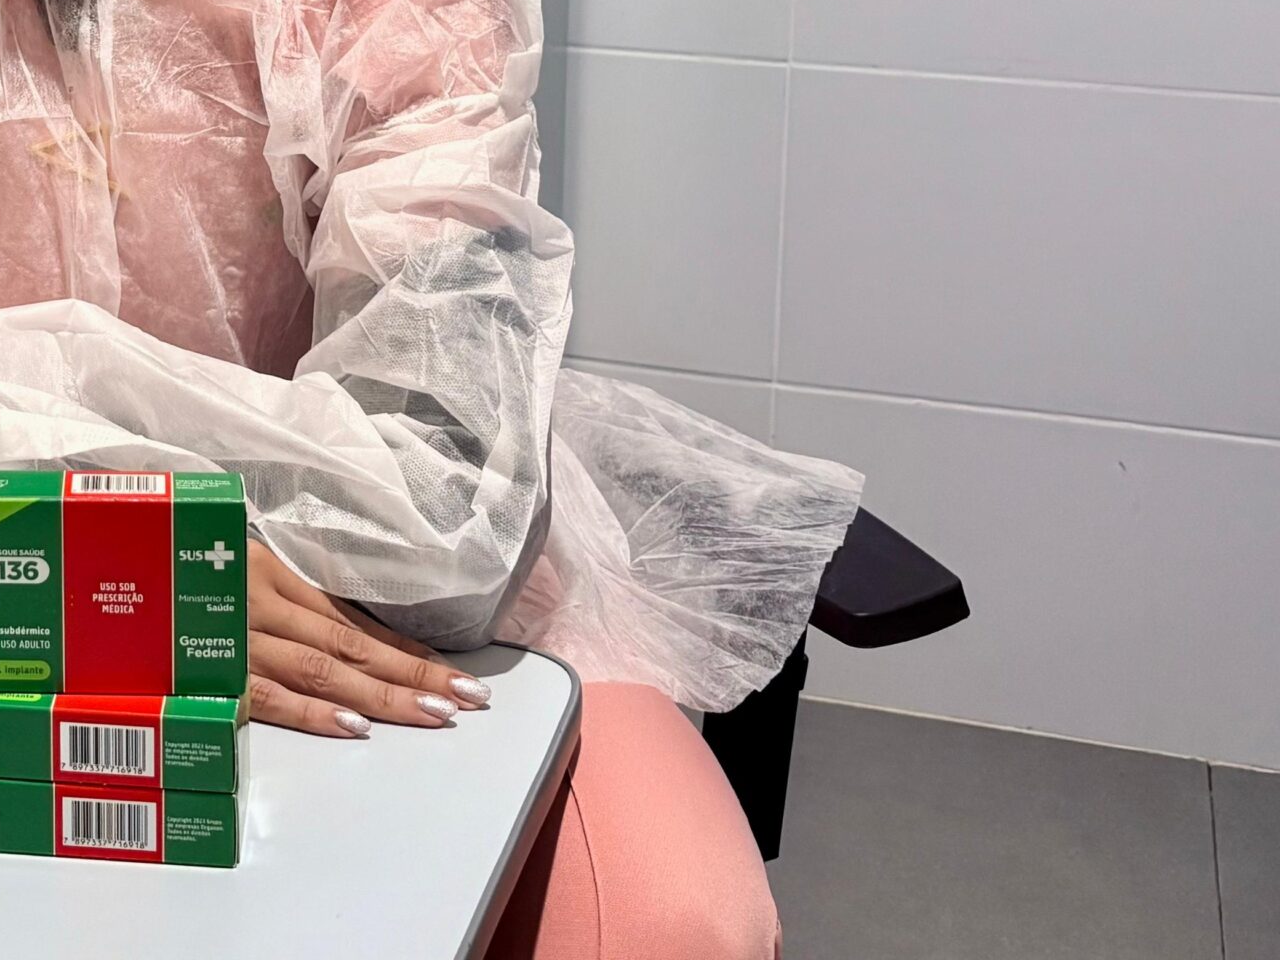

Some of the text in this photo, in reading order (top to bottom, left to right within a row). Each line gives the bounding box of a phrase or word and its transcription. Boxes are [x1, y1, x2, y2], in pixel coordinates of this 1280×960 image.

[19, 548, 44, 556] SAÚDE
[179, 550, 204, 560] SUS
[100, 582, 136, 590] USO SOB
[92, 592, 144, 604] PRESCRIÇÃO
[179, 594, 234, 602] Ministério da
[102, 604, 134, 614] MÉDICA
[206, 603, 234, 612] Saúde
[0, 626, 50, 636] subdérmico
[0, 640, 50, 649] USO ADULTO
[180, 636, 234, 646] Governo
[186, 647, 235, 658] Federal
[4, 666, 44, 677] implante
